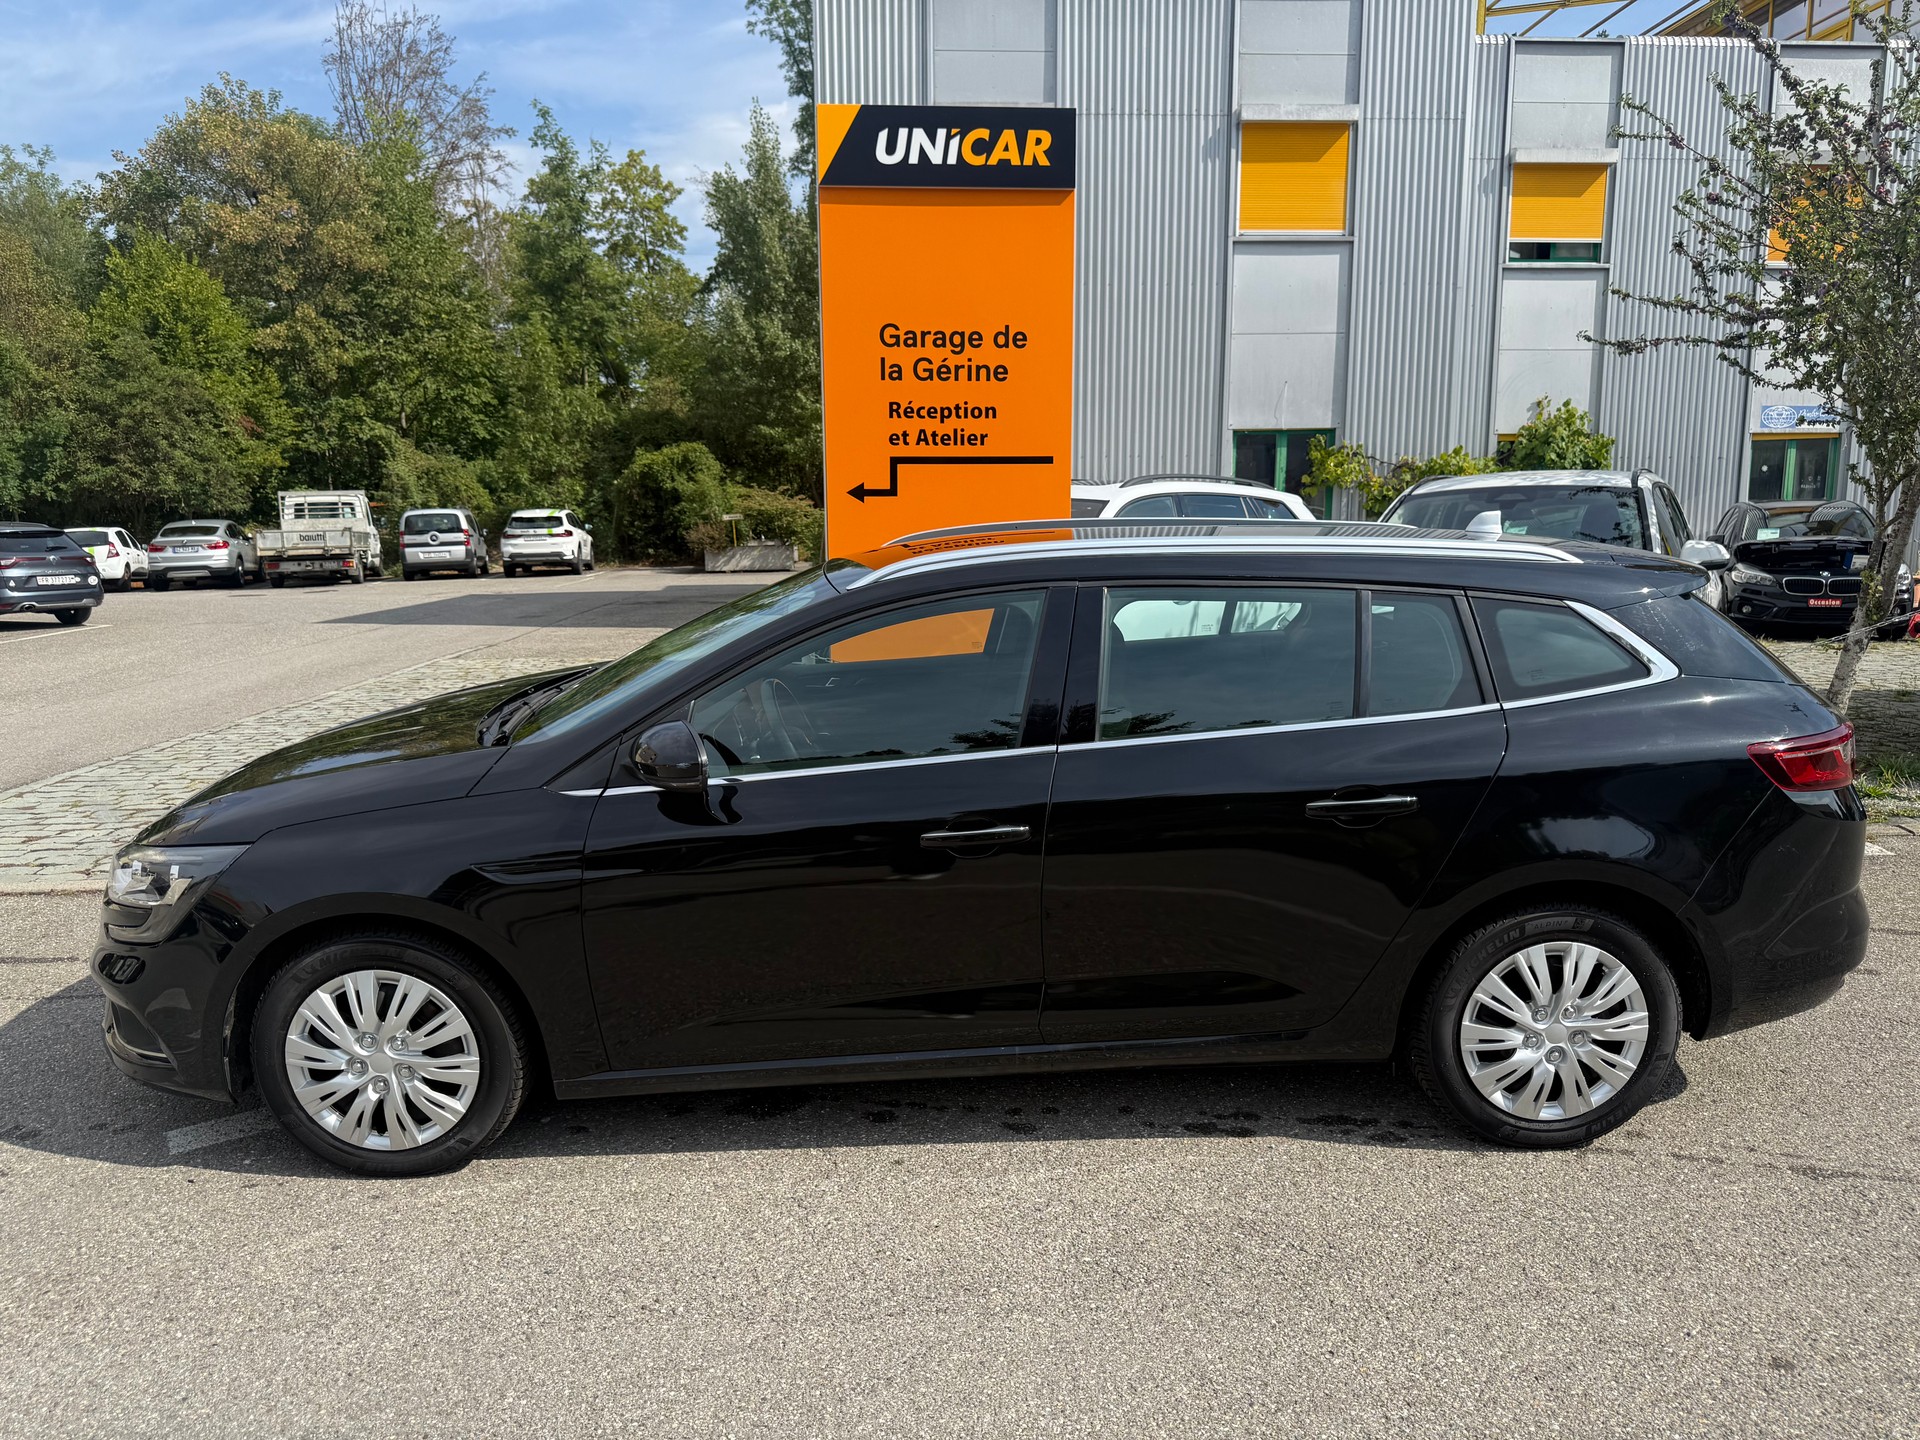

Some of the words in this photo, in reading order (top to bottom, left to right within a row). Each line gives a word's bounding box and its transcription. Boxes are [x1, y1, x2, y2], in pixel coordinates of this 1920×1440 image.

[879, 323, 983, 355] Garage
[993, 324, 1028, 349] de
[880, 357, 903, 381] la
[913, 357, 1009, 382] Gérine
[888, 401, 997, 424] Réception
[888, 430, 910, 446] et
[915, 428, 989, 446] Atelier
[1809, 598, 1841, 606] Occasion
